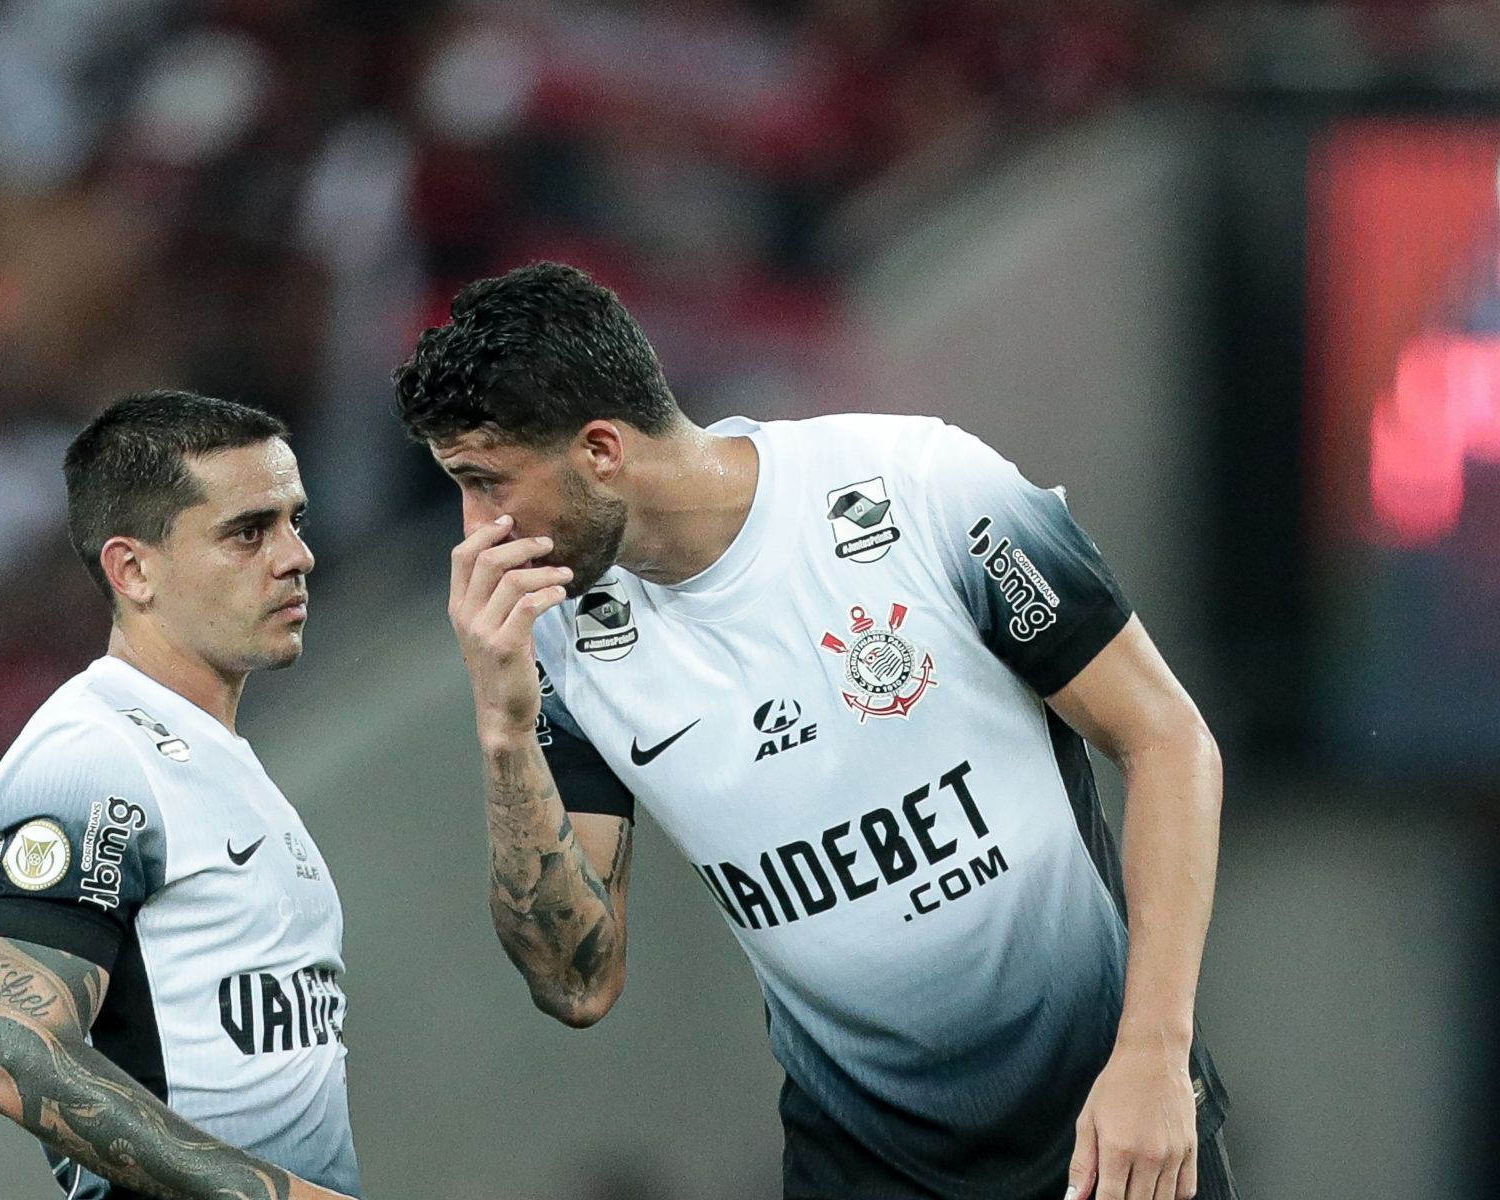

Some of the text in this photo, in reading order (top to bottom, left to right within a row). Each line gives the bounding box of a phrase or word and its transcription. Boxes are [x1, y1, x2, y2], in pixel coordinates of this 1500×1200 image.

[983, 537, 1057, 642] bmg
[1012, 548, 1060, 607] CORINTHIANS
[754, 723, 818, 762] ALE
[81, 802, 102, 871] CORINTHIANS
[81, 795, 147, 894] bmg
[904, 845, 1009, 922] .COM
